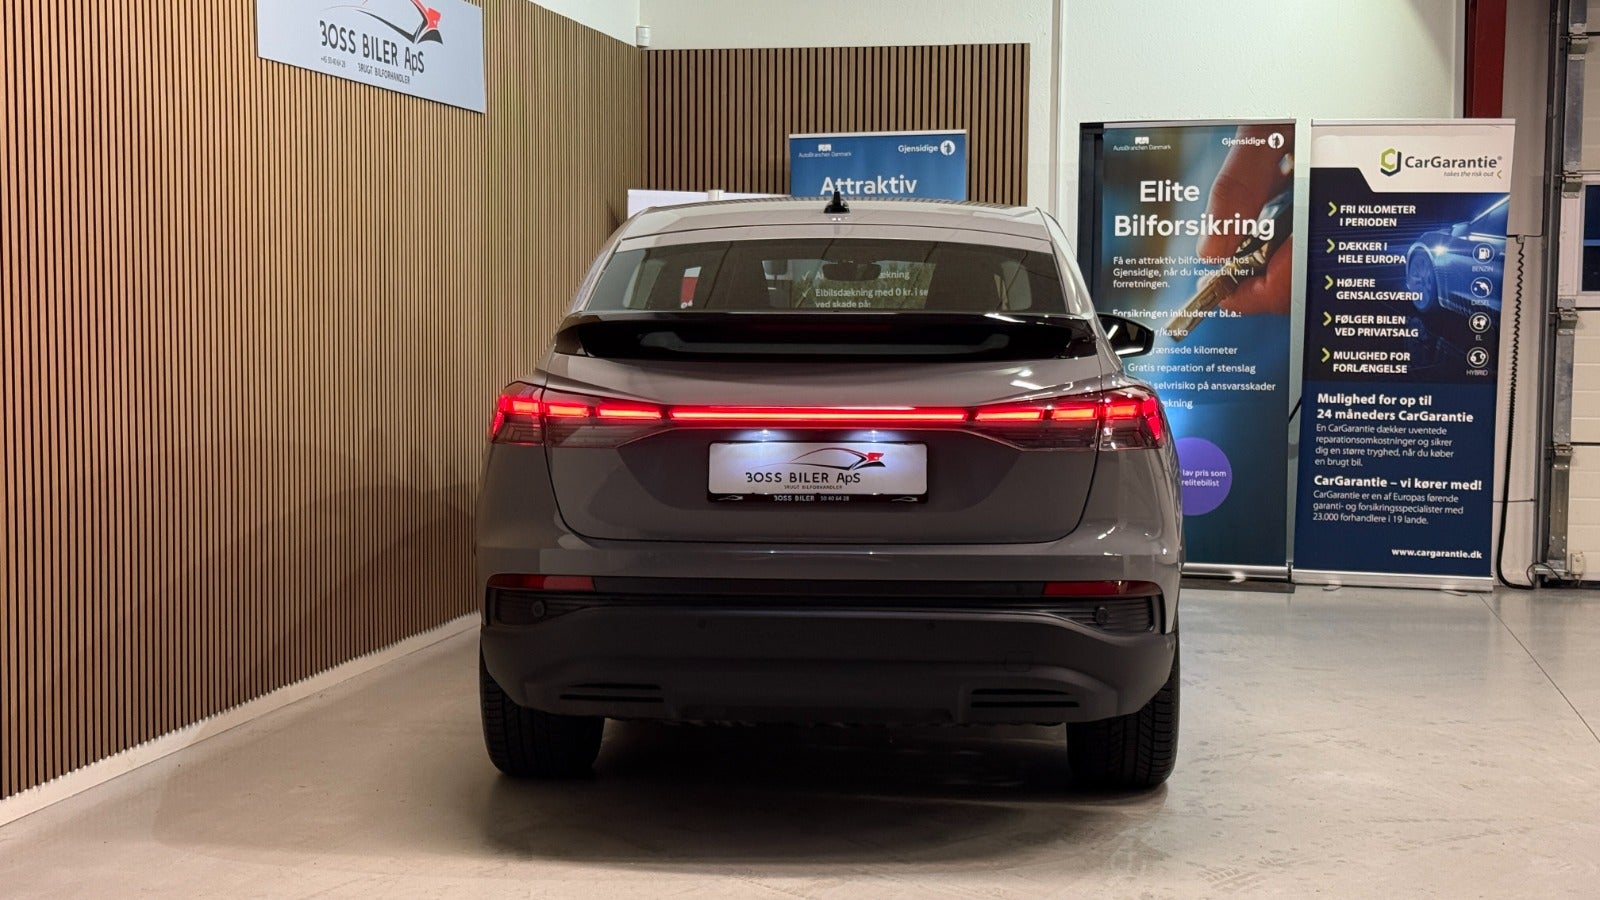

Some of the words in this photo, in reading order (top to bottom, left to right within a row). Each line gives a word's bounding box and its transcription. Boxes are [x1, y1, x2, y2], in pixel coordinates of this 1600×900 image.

[362, 33, 399, 67] BILER
[404, 47, 425, 76] ApS
[375, 67, 410, 84] BILFORHANDLER
[1222, 137, 1266, 147] Gjensidige
[898, 144, 938, 153] Gjensidige
[1405, 155, 1497, 169] CarGarantie
[820, 174, 917, 195] Attraktiv
[1139, 179, 1200, 202] Elite
[1340, 205, 1356, 215] FRI
[1358, 205, 1416, 215] KILOMETER
[1114, 213, 1275, 241] Bilforsikring
[1339, 218, 1344, 227] I
[1345, 218, 1397, 227] PERIODEN
[1338, 242, 1382, 251] DÆKKER
[1384, 242, 1388, 251] I
[1113, 257, 1124, 265] Få
[1138, 256, 1177, 265] attraktiv
[1178, 256, 1231, 266] bilforsikring
[1233, 256, 1249, 264] hos
[1338, 254, 1364, 264] HELE
[1365, 254, 1407, 264] EUROPA
[1113, 267, 1162, 278] Gjensidige,
[1164, 268, 1178, 276] når
[1180, 268, 1191, 276] du
[1221, 268, 1232, 276] bil
[1234, 268, 1249, 276] her
[1113, 280, 1170, 290] forretningen.
[1336, 278, 1376, 288] HØJERE
[815, 288, 873, 298] Elbilsdækning
[874, 288, 894, 297] med
[895, 288, 902, 296] 0
[902, 287, 913, 297] kr.
[1336, 291, 1423, 301] GENSALGSVÆRDI
[815, 300, 831, 308] ved
[832, 300, 857, 308] skade
[1113, 309, 1169, 319] Forsikringen
[1170, 309, 1217, 318] inkluderer
[1220, 309, 1242, 318] bl.a.:
[1335, 314, 1374, 325] FØLGER
[1376, 315, 1406, 325] BILEN
[1155, 327, 1188, 337] r/kasko
[1335, 327, 1356, 337] VED
[1357, 328, 1419, 338] PRIVATSALG
[1193, 346, 1238, 355] kilometer
[1333, 351, 1387, 361] MULIGHED
[1390, 351, 1411, 361] FOR
[1128, 363, 1155, 372] Gratis
[1157, 363, 1204, 374] reparation
[1205, 363, 1215, 372] af
[1217, 363, 1256, 375] stenslag
[1333, 364, 1408, 374] FORLÆNGELSE
[1154, 382, 1196, 390] selvrisiko
[1197, 382, 1209, 392] på
[1211, 382, 1276, 391] ansvarsskader
[1317, 393, 1376, 406] Mulighed
[1378, 393, 1396, 405] for
[1399, 396, 1416, 407] op
[1418, 395, 1433, 406] til
[1316, 409, 1333, 419] 24
[1335, 409, 1396, 421] måneders
[1398, 410, 1474, 423] CarGarantie
[1316, 424, 1327, 432] En
[1328, 424, 1375, 433] CarGarantie
[1376, 425, 1407, 434] dækker
[1408, 426, 1447, 435] uventede
[1315, 435, 1416, 447] reparationsomkostninger
[1417, 440, 1429, 448] og
[1430, 438, 1453, 447] sikrer
[1315, 446, 1328, 456] dig
[1342, 447, 1366, 455] større
[1402, 449, 1415, 457] når
[1417, 449, 1428, 457] du
[1430, 449, 1454, 458] køber
[1327, 458, 1349, 468] brugt
[1351, 458, 1363, 467] bil.
[789, 472, 829, 483] BILER
[836, 472, 861, 485] ApS
[1182, 469, 1194, 477] lav
[1194, 469, 1209, 478] pris
[1181, 479, 1220, 487] relitebilist
[1314, 475, 1388, 488] CarGarantie
[1400, 478, 1412, 488] vi
[1414, 478, 1448, 490] kører
[1450, 479, 1482, 491] med!
[1313, 489, 1360, 500] CarGarantie
[1383, 492, 1393, 500] af
[1393, 492, 1426, 503] Europas
[1426, 493, 1459, 503] førende
[1312, 502, 1344, 512] garanti-
[1358, 503, 1443, 514] forsikringsspecialister
[1444, 506, 1464, 515] med
[1312, 512, 1339, 521] 23.000
[1340, 513, 1386, 523] forhandlere
[1404, 516, 1429, 525] lande.
[1391, 548, 1483, 559] www.cargarantie.dk
